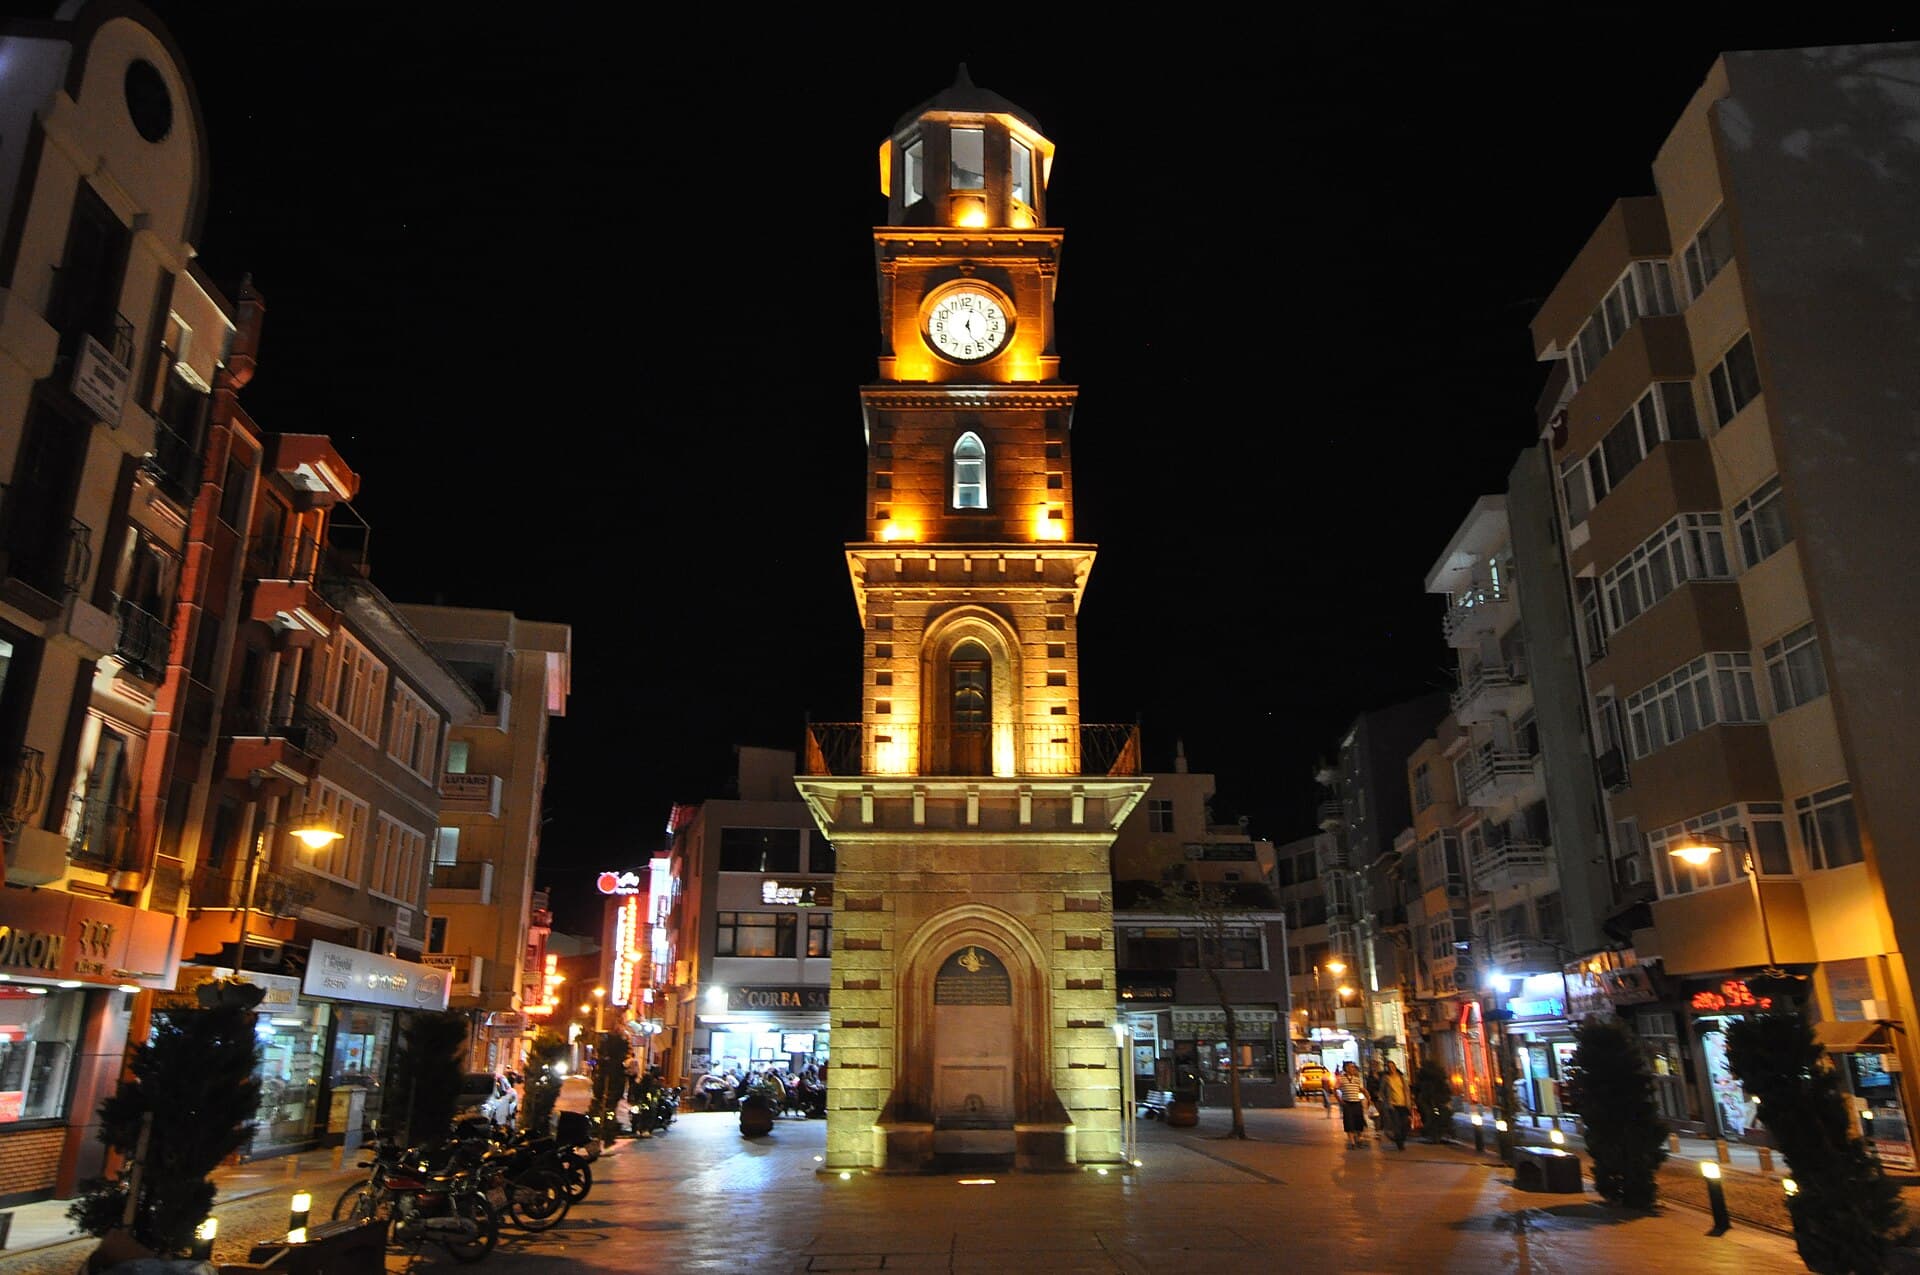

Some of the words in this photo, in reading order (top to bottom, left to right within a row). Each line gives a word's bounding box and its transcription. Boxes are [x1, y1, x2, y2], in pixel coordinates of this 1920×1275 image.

[962, 298, 972, 306] 12
[938, 310, 948, 320] 10
[988, 309, 994, 318] 2
[936, 322, 944, 332] 9
[992, 322, 998, 330] 3
[940, 334, 948, 344] 8
[988, 334, 994, 342] 4
[952, 343, 958, 352] 7
[965, 345, 972, 354] 6
[977, 342, 984, 352] 5
[424, 957, 456, 965] VUKAT
[807, 991, 830, 1007] SA
